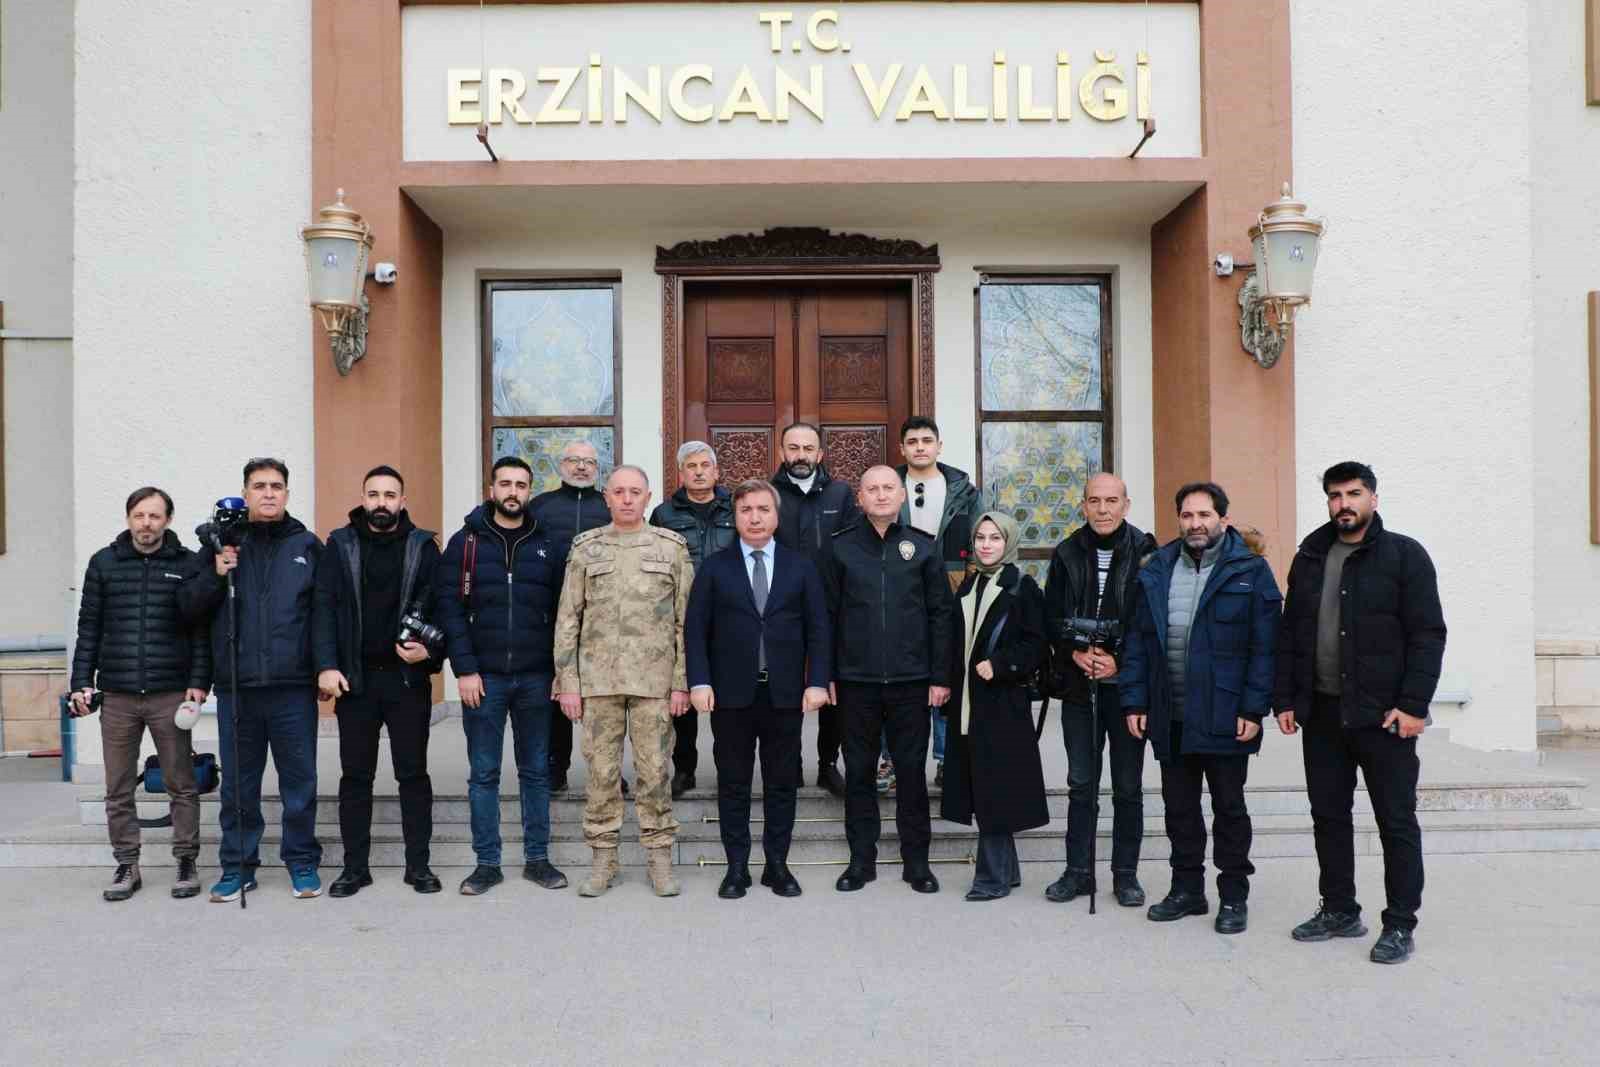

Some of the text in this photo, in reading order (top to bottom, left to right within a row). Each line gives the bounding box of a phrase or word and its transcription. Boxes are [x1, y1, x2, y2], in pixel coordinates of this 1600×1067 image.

[758, 10, 851, 53] T.C.
[447, 49, 1152, 125] ERZİNCAN VALİLİĞİ
